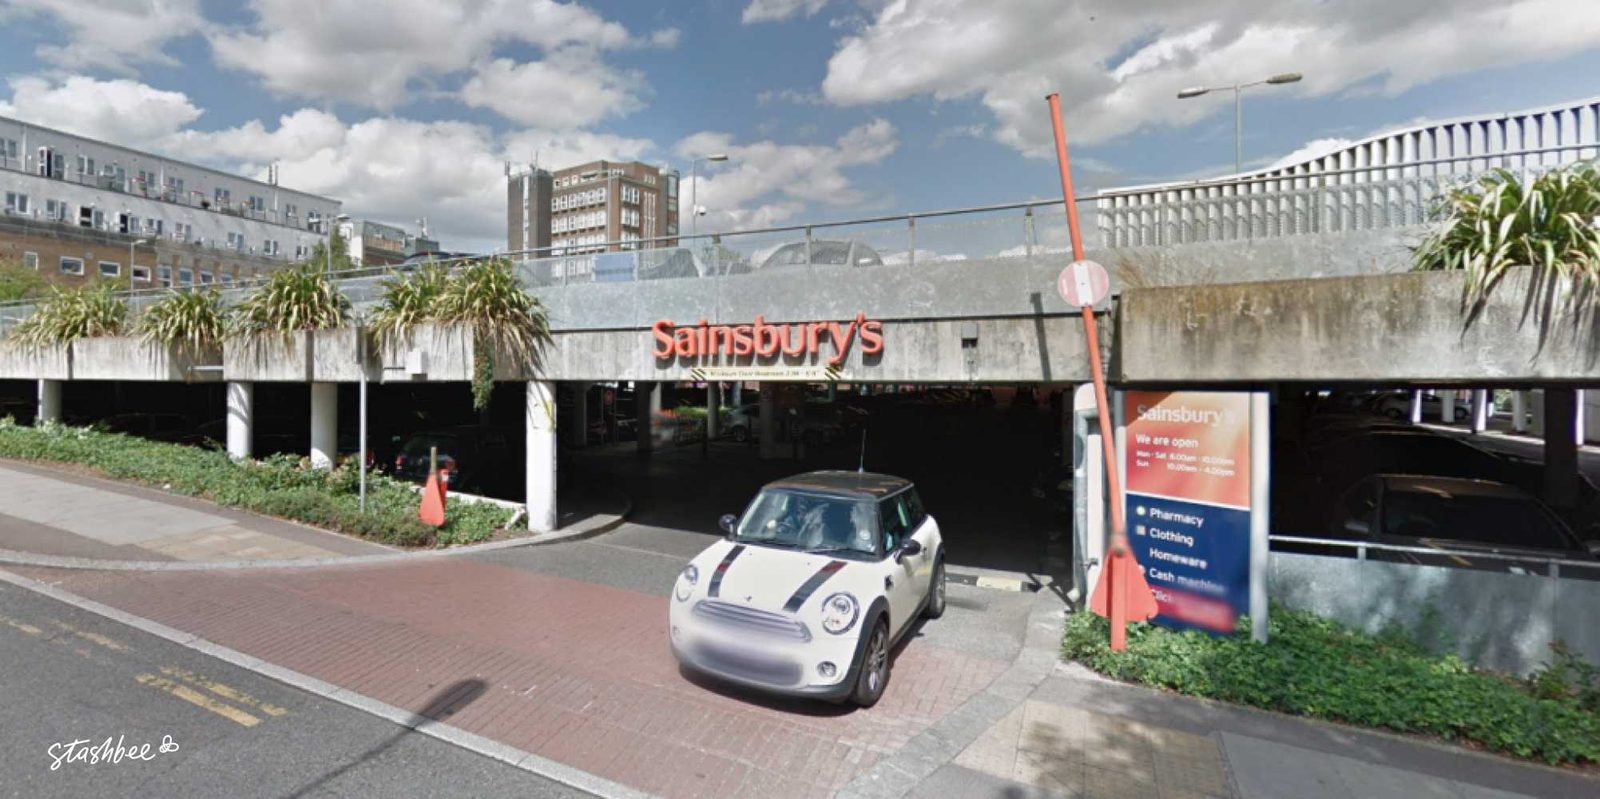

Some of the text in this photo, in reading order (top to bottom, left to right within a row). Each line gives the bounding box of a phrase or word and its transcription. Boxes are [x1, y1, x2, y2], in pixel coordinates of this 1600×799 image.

[652, 310, 884, 365] Sainsbury's
[1136, 434, 1199, 449] We are open
[1136, 450, 1151, 458] Mon
[1155, 452, 1166, 460] Sat
[1136, 459, 1149, 467] Sun
[1149, 507, 1204, 528] Pharmacy
[1149, 528, 1194, 547] Clothing
[1149, 547, 1208, 569] Homeware
[1149, 568, 1175, 582] Cash
